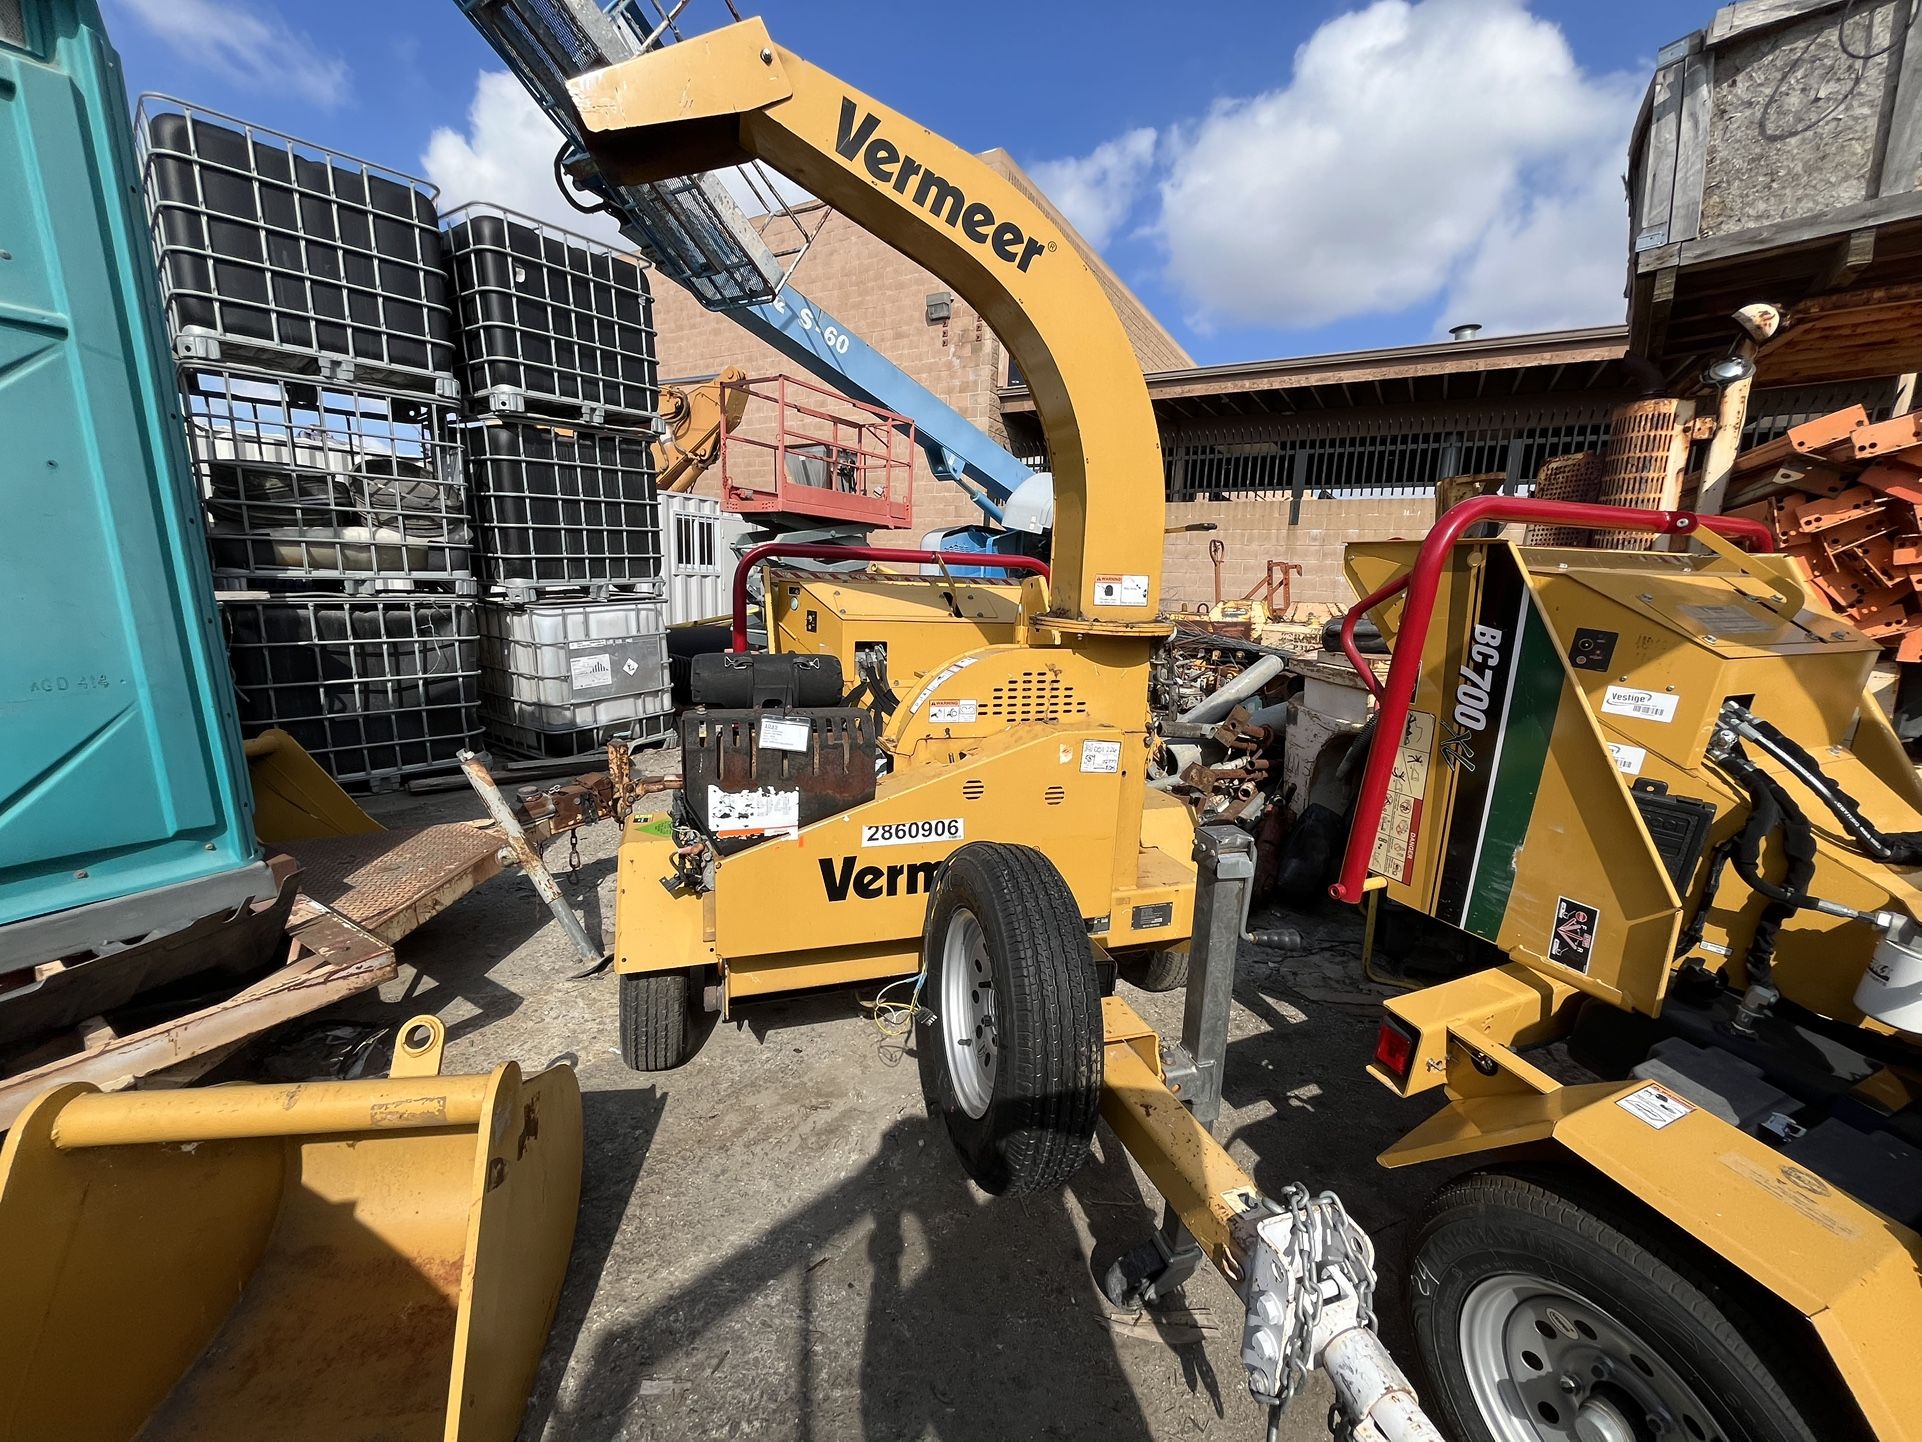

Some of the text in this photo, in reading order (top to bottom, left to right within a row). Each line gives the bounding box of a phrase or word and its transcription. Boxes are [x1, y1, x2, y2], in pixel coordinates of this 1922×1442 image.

[835, 97, 1044, 273] Vermeer
[798, 308, 850, 354] S-60
[1453, 623, 1503, 732] BC700
[1612, 692, 1646, 703] Vestige
[867, 819, 959, 842] 2860906
[1406, 832, 1417, 860] DANGER
